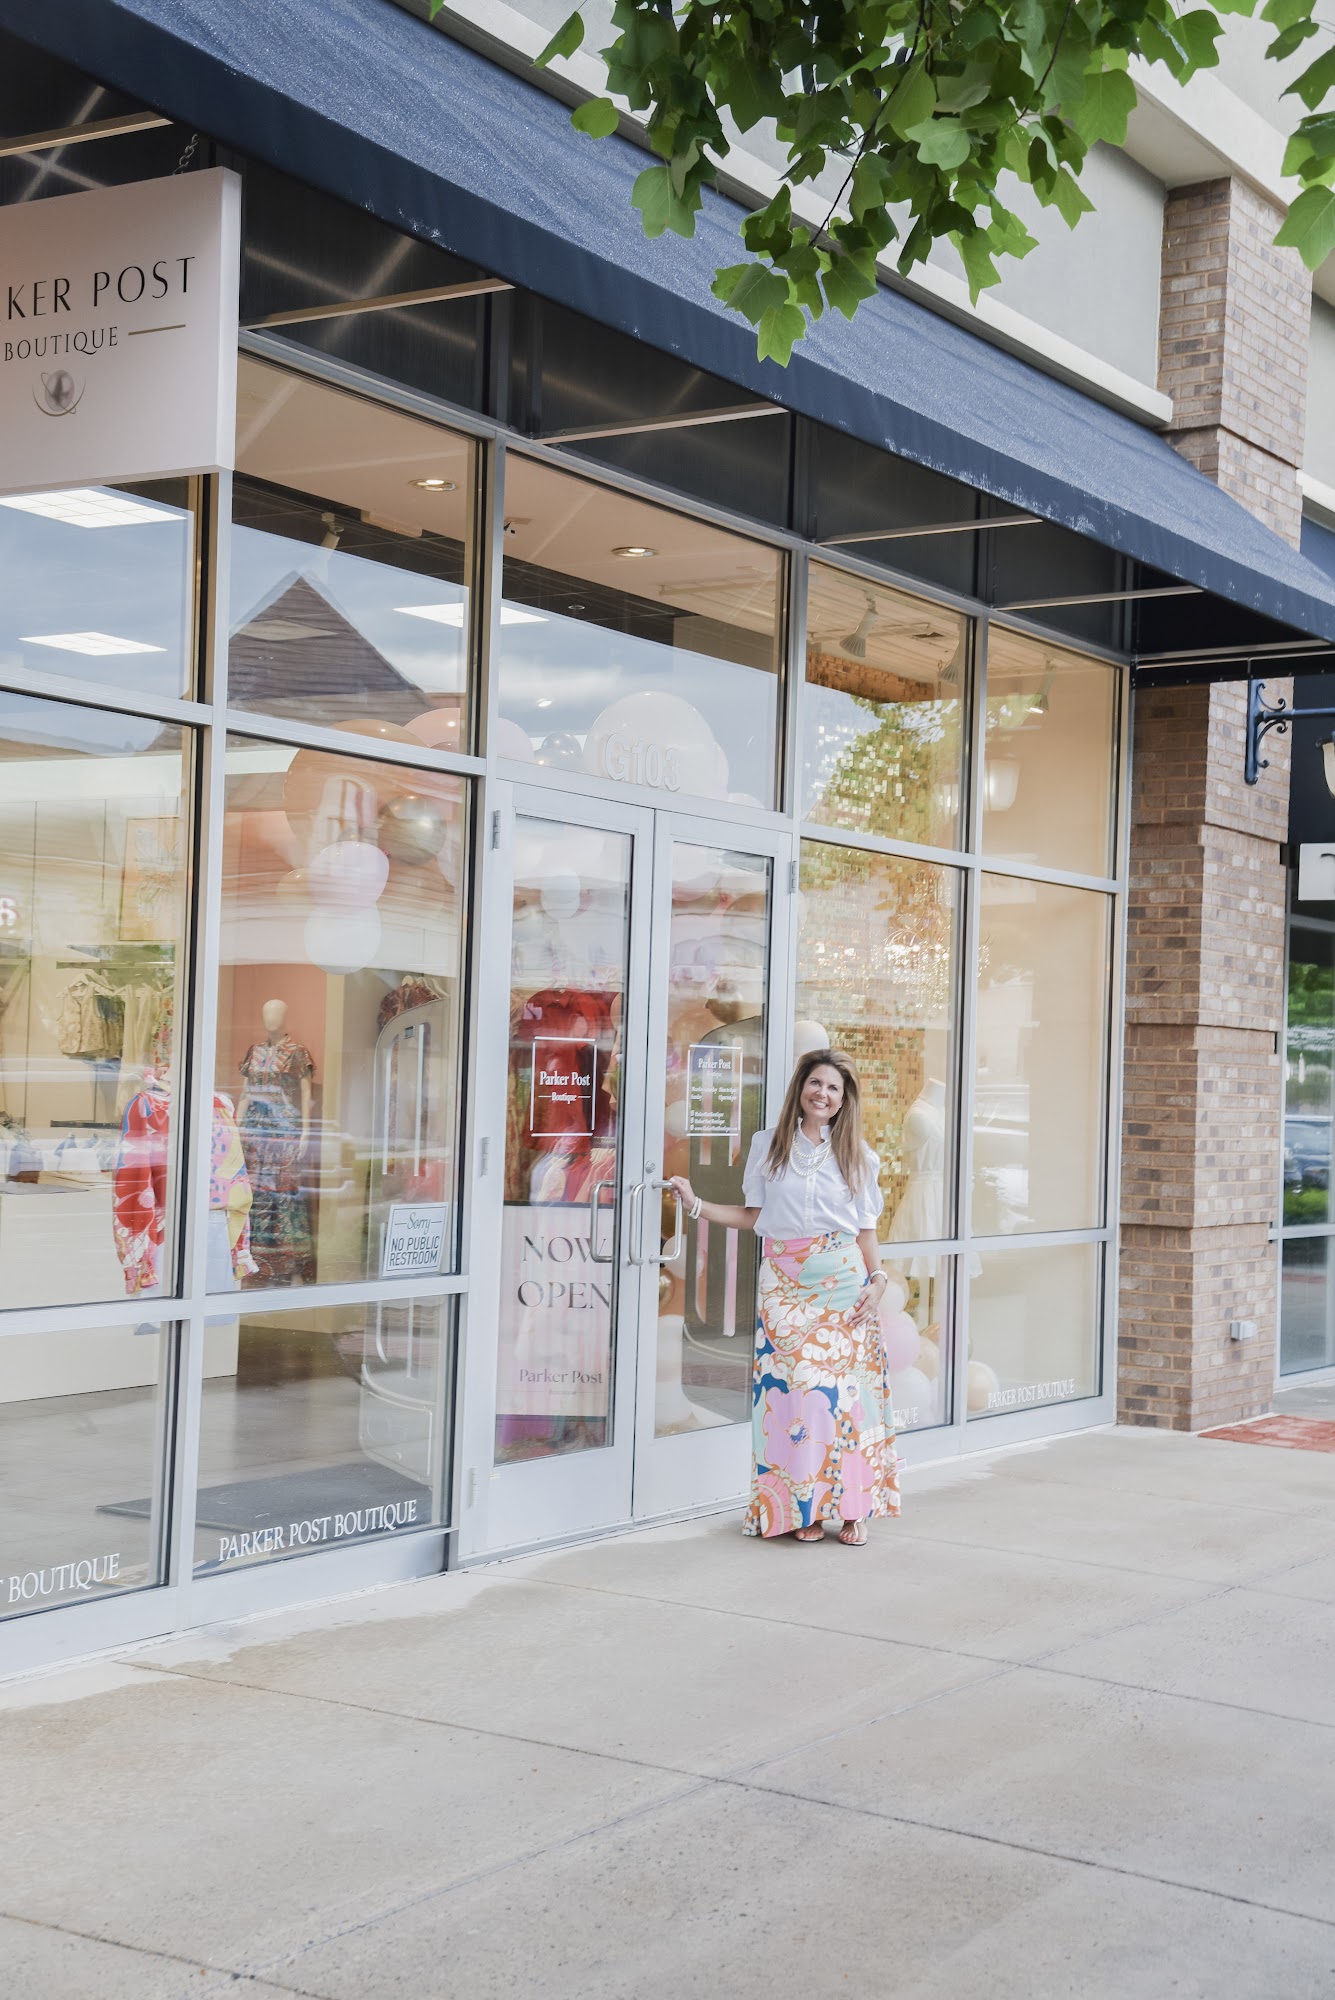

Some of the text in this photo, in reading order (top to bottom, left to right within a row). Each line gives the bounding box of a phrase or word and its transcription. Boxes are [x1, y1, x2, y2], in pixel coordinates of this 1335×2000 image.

[0, 256, 196, 321] KER POST
[4, 326, 119, 361] BOUTIQUE
[605, 732, 681, 792] G103
[539, 1070, 591, 1086] Parker Post
[407, 1211, 431, 1235] Sorry
[389, 1250, 438, 1266] RESTROOM
[391, 1236, 440, 1252] NO PUBLIC
[523, 1235, 607, 1263] NOW
[517, 1280, 611, 1309] OPEN
[520, 1368, 604, 1384] Parker Post
[988, 1378, 1075, 1409] PARKER POST BOUTIQUE
[218, 1499, 418, 1562] PARKER POST BOUTIQUE
[8, 1553, 120, 1603] BOUTIQUE
